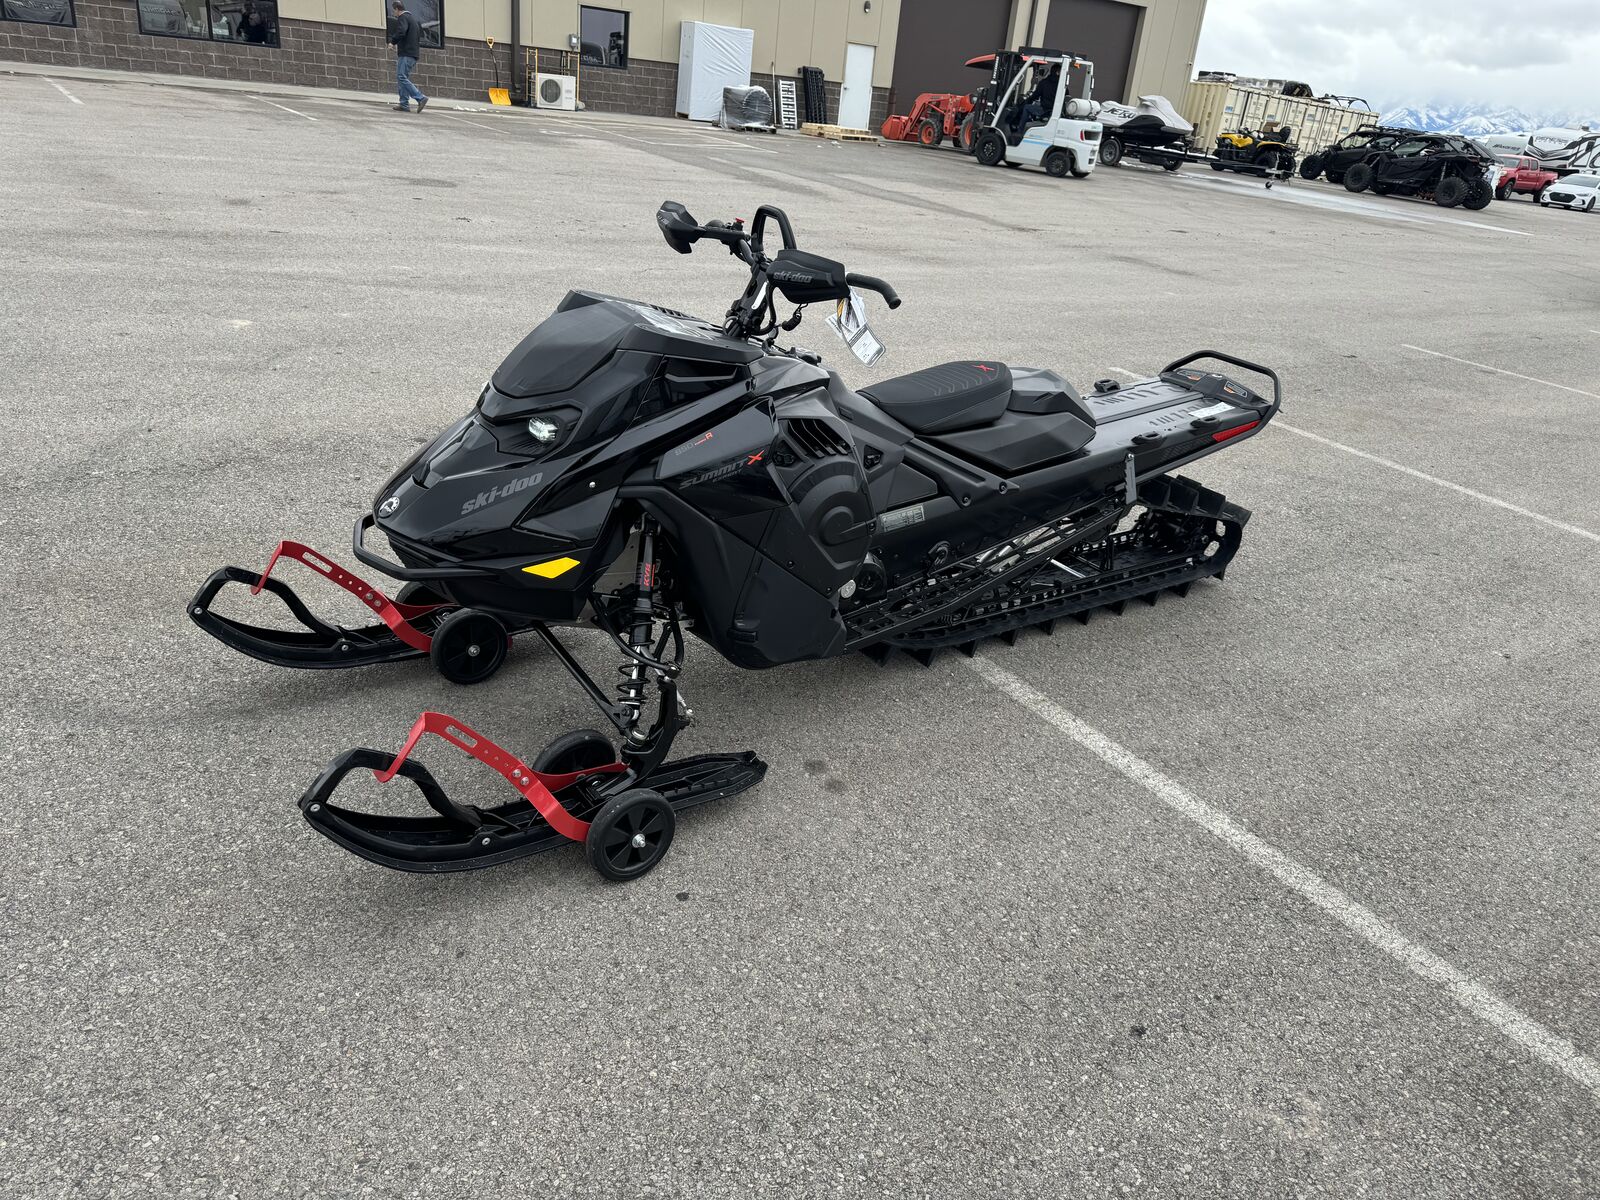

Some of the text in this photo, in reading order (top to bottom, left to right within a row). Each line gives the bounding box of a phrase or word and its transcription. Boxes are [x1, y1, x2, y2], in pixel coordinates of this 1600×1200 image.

[773, 270, 813, 283] ski-doo
[746, 449, 765, 465] X
[461, 472, 544, 515] ski-doo
